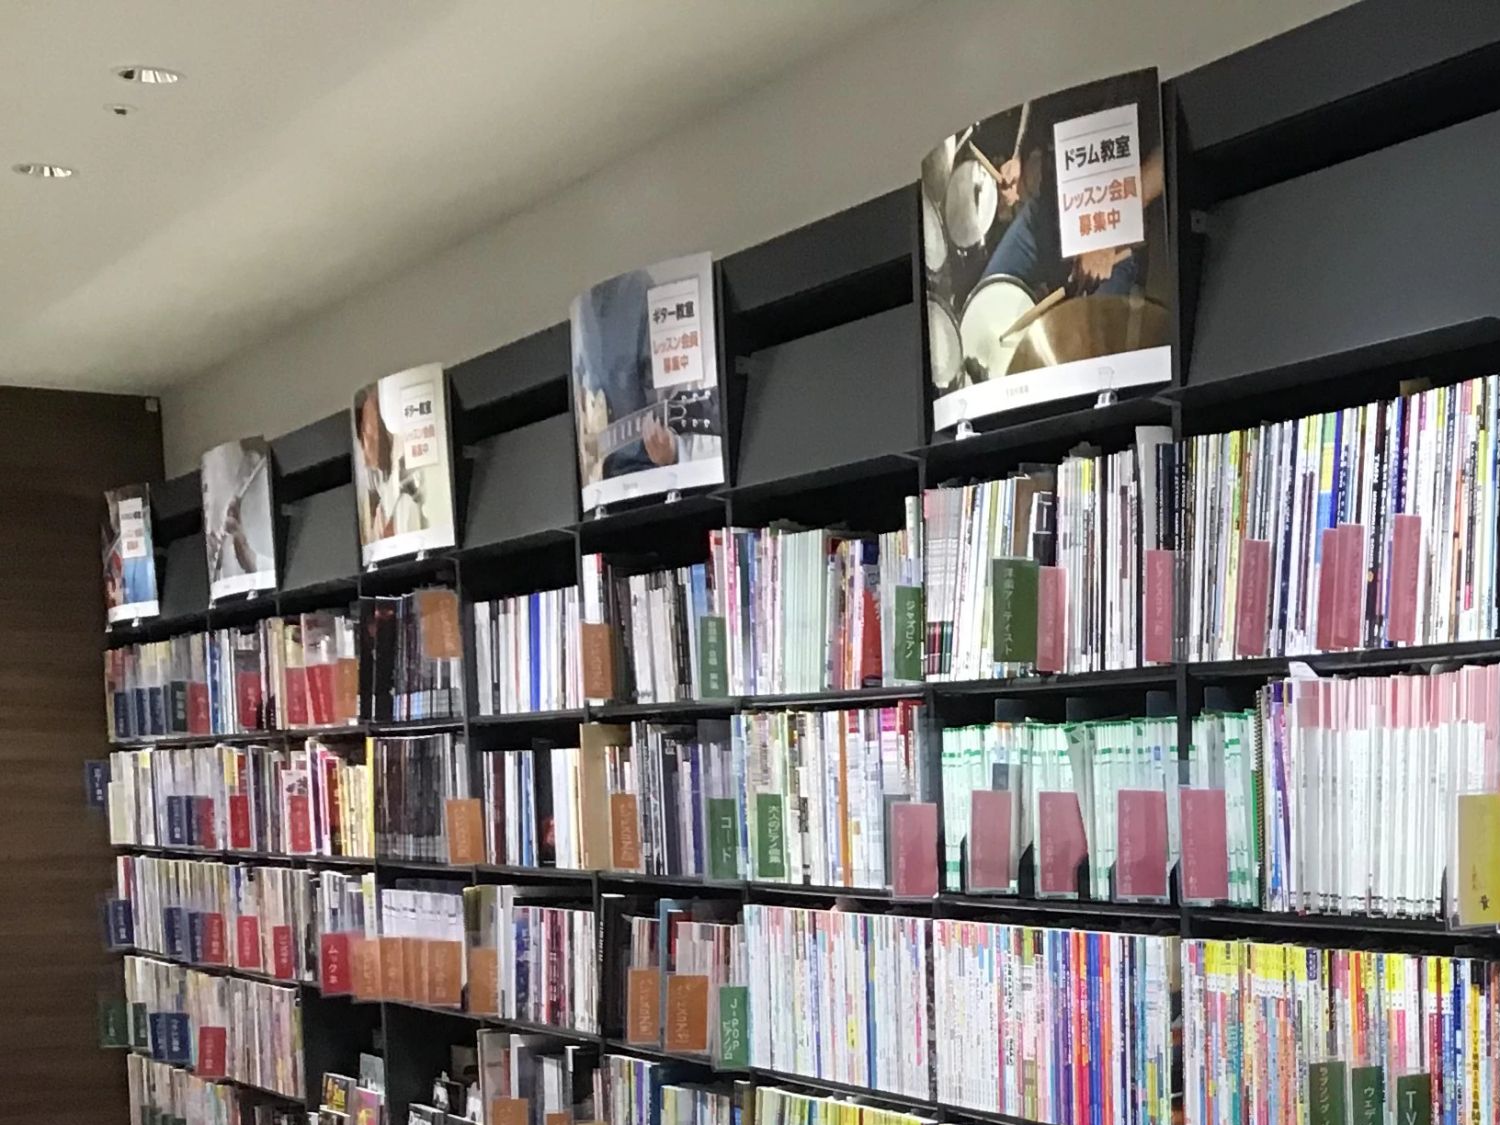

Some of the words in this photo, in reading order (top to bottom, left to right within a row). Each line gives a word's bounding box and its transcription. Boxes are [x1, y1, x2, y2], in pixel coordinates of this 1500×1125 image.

[1063, 135, 1131, 171] ドラム教室
[1062, 176, 1138, 209] レッスン会員
[1078, 208, 1122, 238] 募集中
[652, 300, 695, 325] ギター教室
[719, 815, 732, 861] コード
